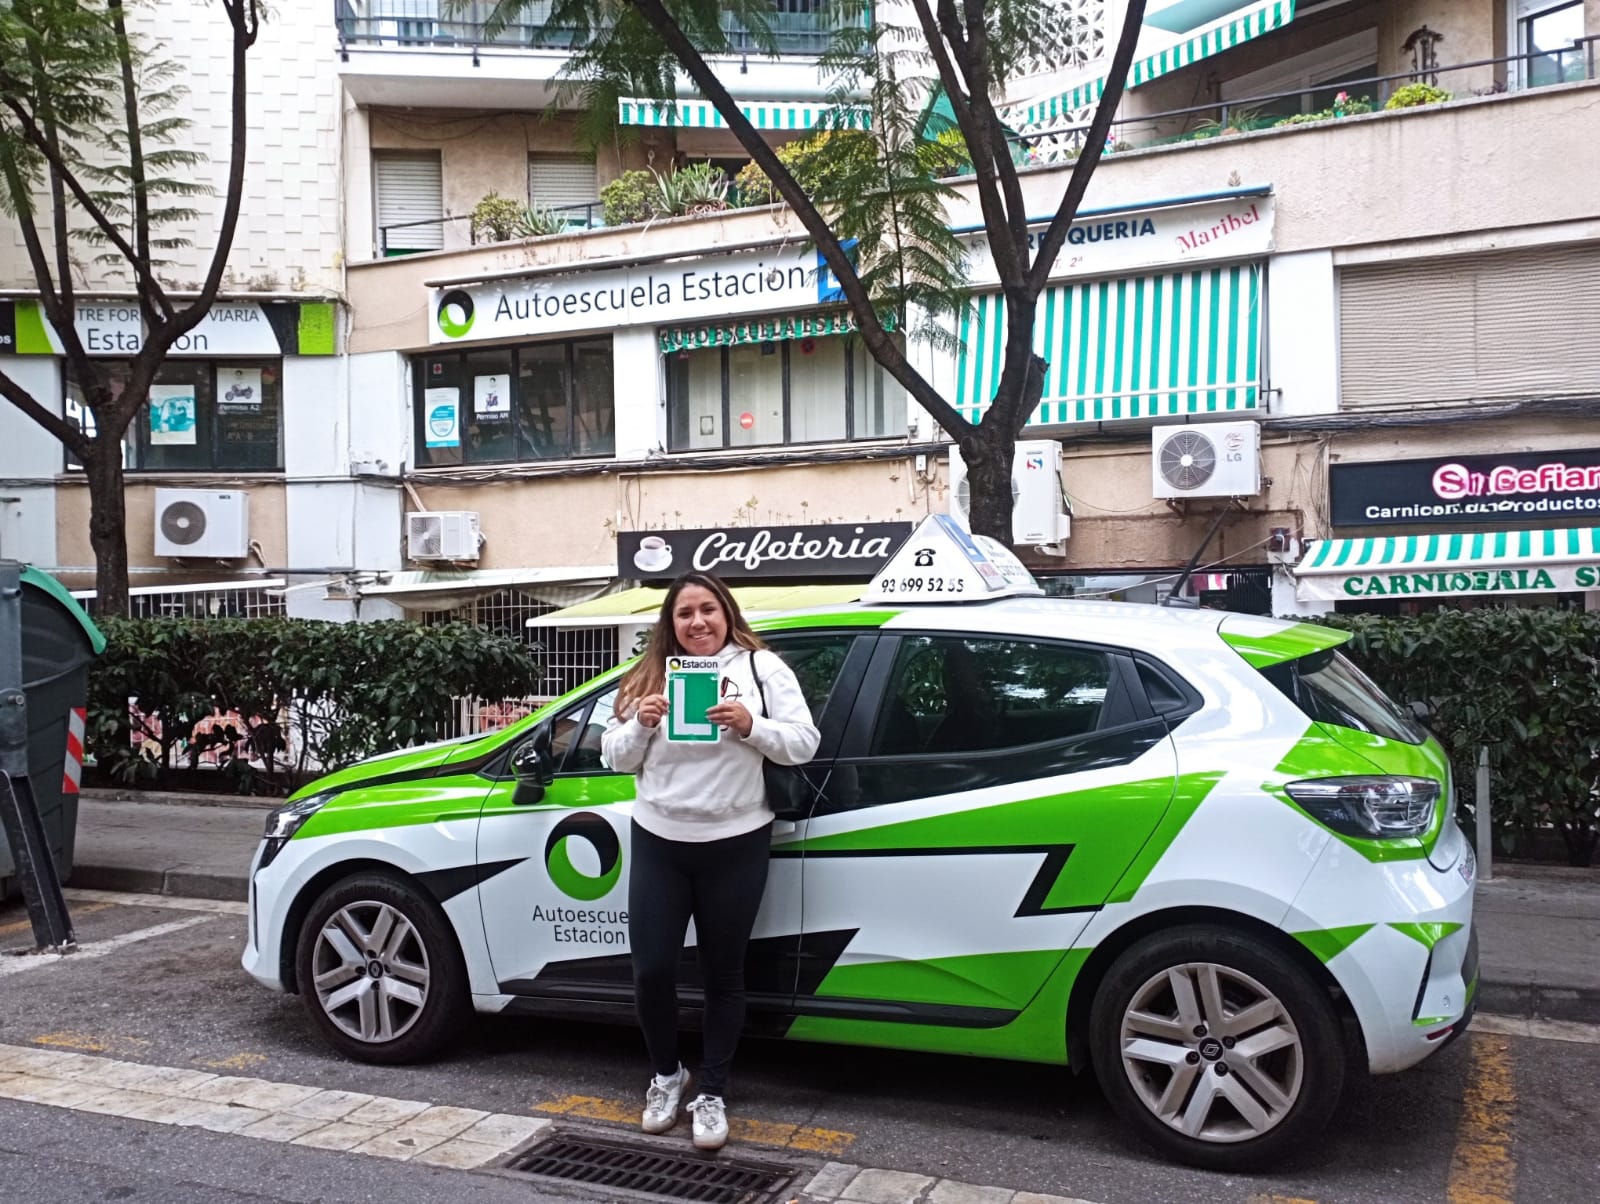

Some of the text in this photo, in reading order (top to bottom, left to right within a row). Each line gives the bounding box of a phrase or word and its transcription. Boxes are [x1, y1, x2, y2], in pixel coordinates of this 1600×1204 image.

[1176, 203, 1261, 254] Maribel
[495, 275, 671, 322] Autoescuela
[87, 328, 208, 351] Estaon
[1226, 452, 1243, 463] LG
[692, 526, 891, 571] Cafeteria
[881, 578, 896, 593] 93
[927, 577, 944, 592] 52
[681, 659, 719, 670] Estacion
[532, 904, 630, 925] Autoescue
[553, 924, 626, 945] Estacion
